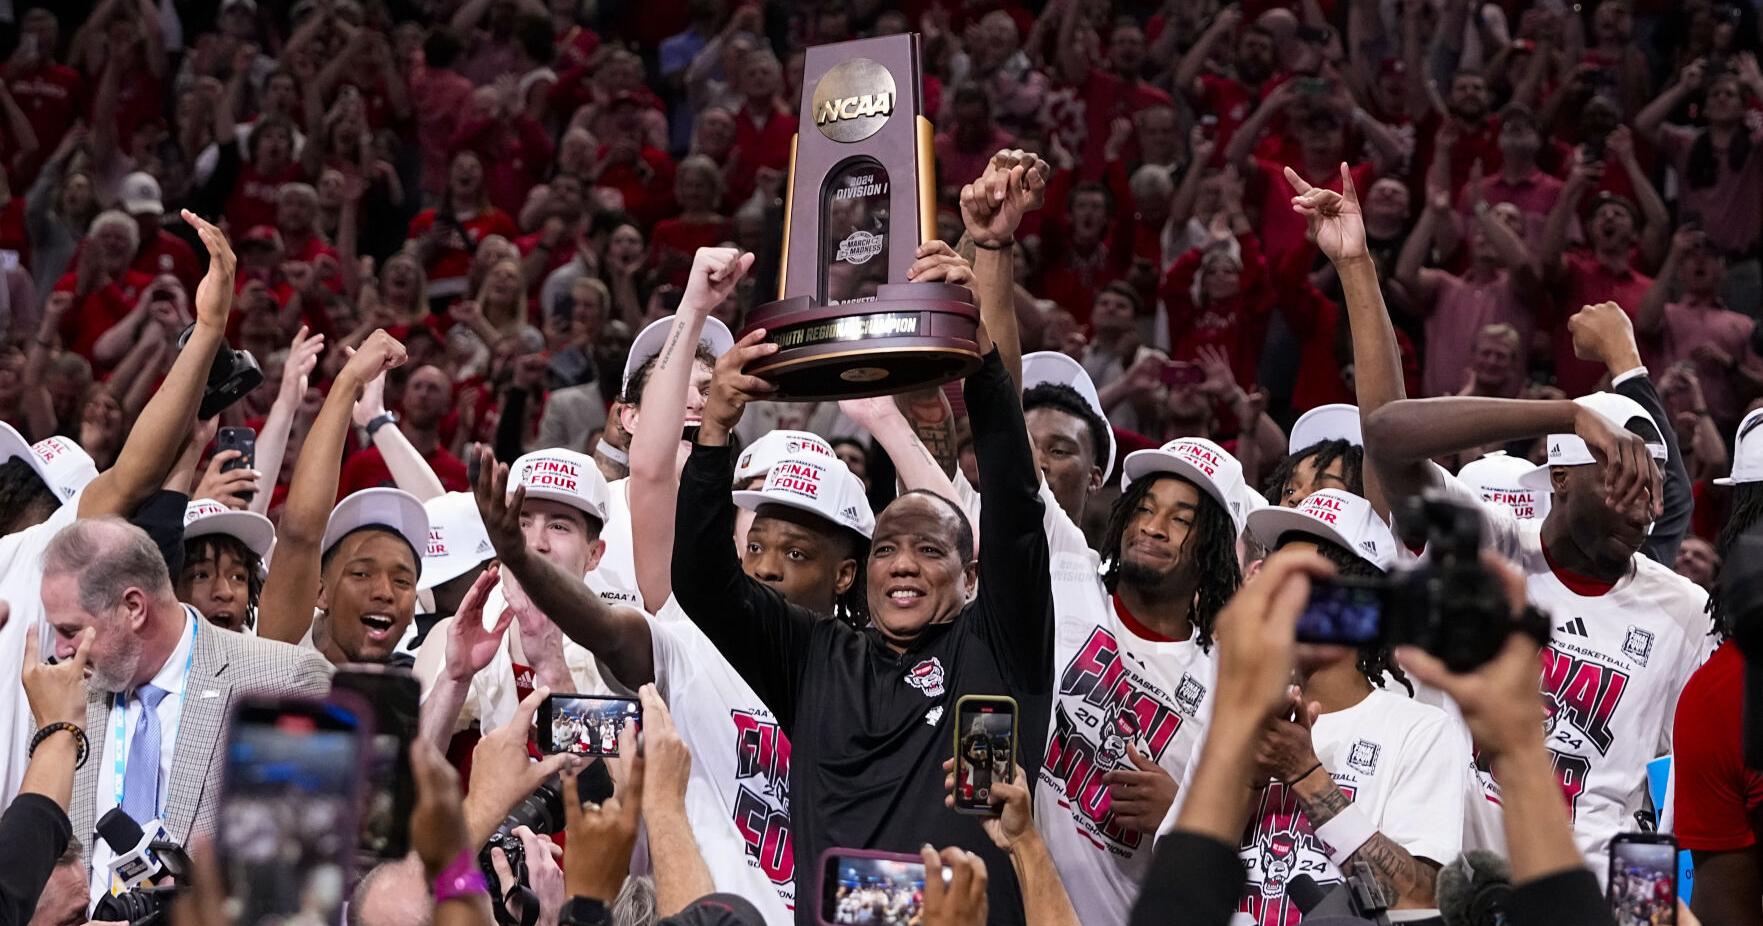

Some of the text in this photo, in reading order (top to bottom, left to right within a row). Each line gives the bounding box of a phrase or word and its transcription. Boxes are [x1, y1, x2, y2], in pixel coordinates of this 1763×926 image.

[817, 93, 893, 125] NCAA
[849, 174, 874, 187] 2024
[836, 182, 889, 200] DIVISION I
[846, 238, 872, 248] MARCH
[848, 244, 881, 255] MADNESS
[774, 316, 917, 348] SOUTH REGIONA CHAMPION
[1177, 444, 1220, 467] FINAL
[534, 461, 579, 477] FINAL
[780, 463, 821, 481] FINAL
[531, 475, 577, 491] FOUR
[774, 477, 818, 495] FOUR
[1301, 496, 1342, 512] FINAL
[1493, 492, 1534, 503] FINAL
[600, 591, 627, 601] NCAA
[1566, 642, 1632, 671] BASKETBALL
[1074, 707, 1099, 728] 20
[1556, 731, 1583, 750] 24
[1039, 772, 1065, 795] SOUTH
[1299, 859, 1328, 873] 24
